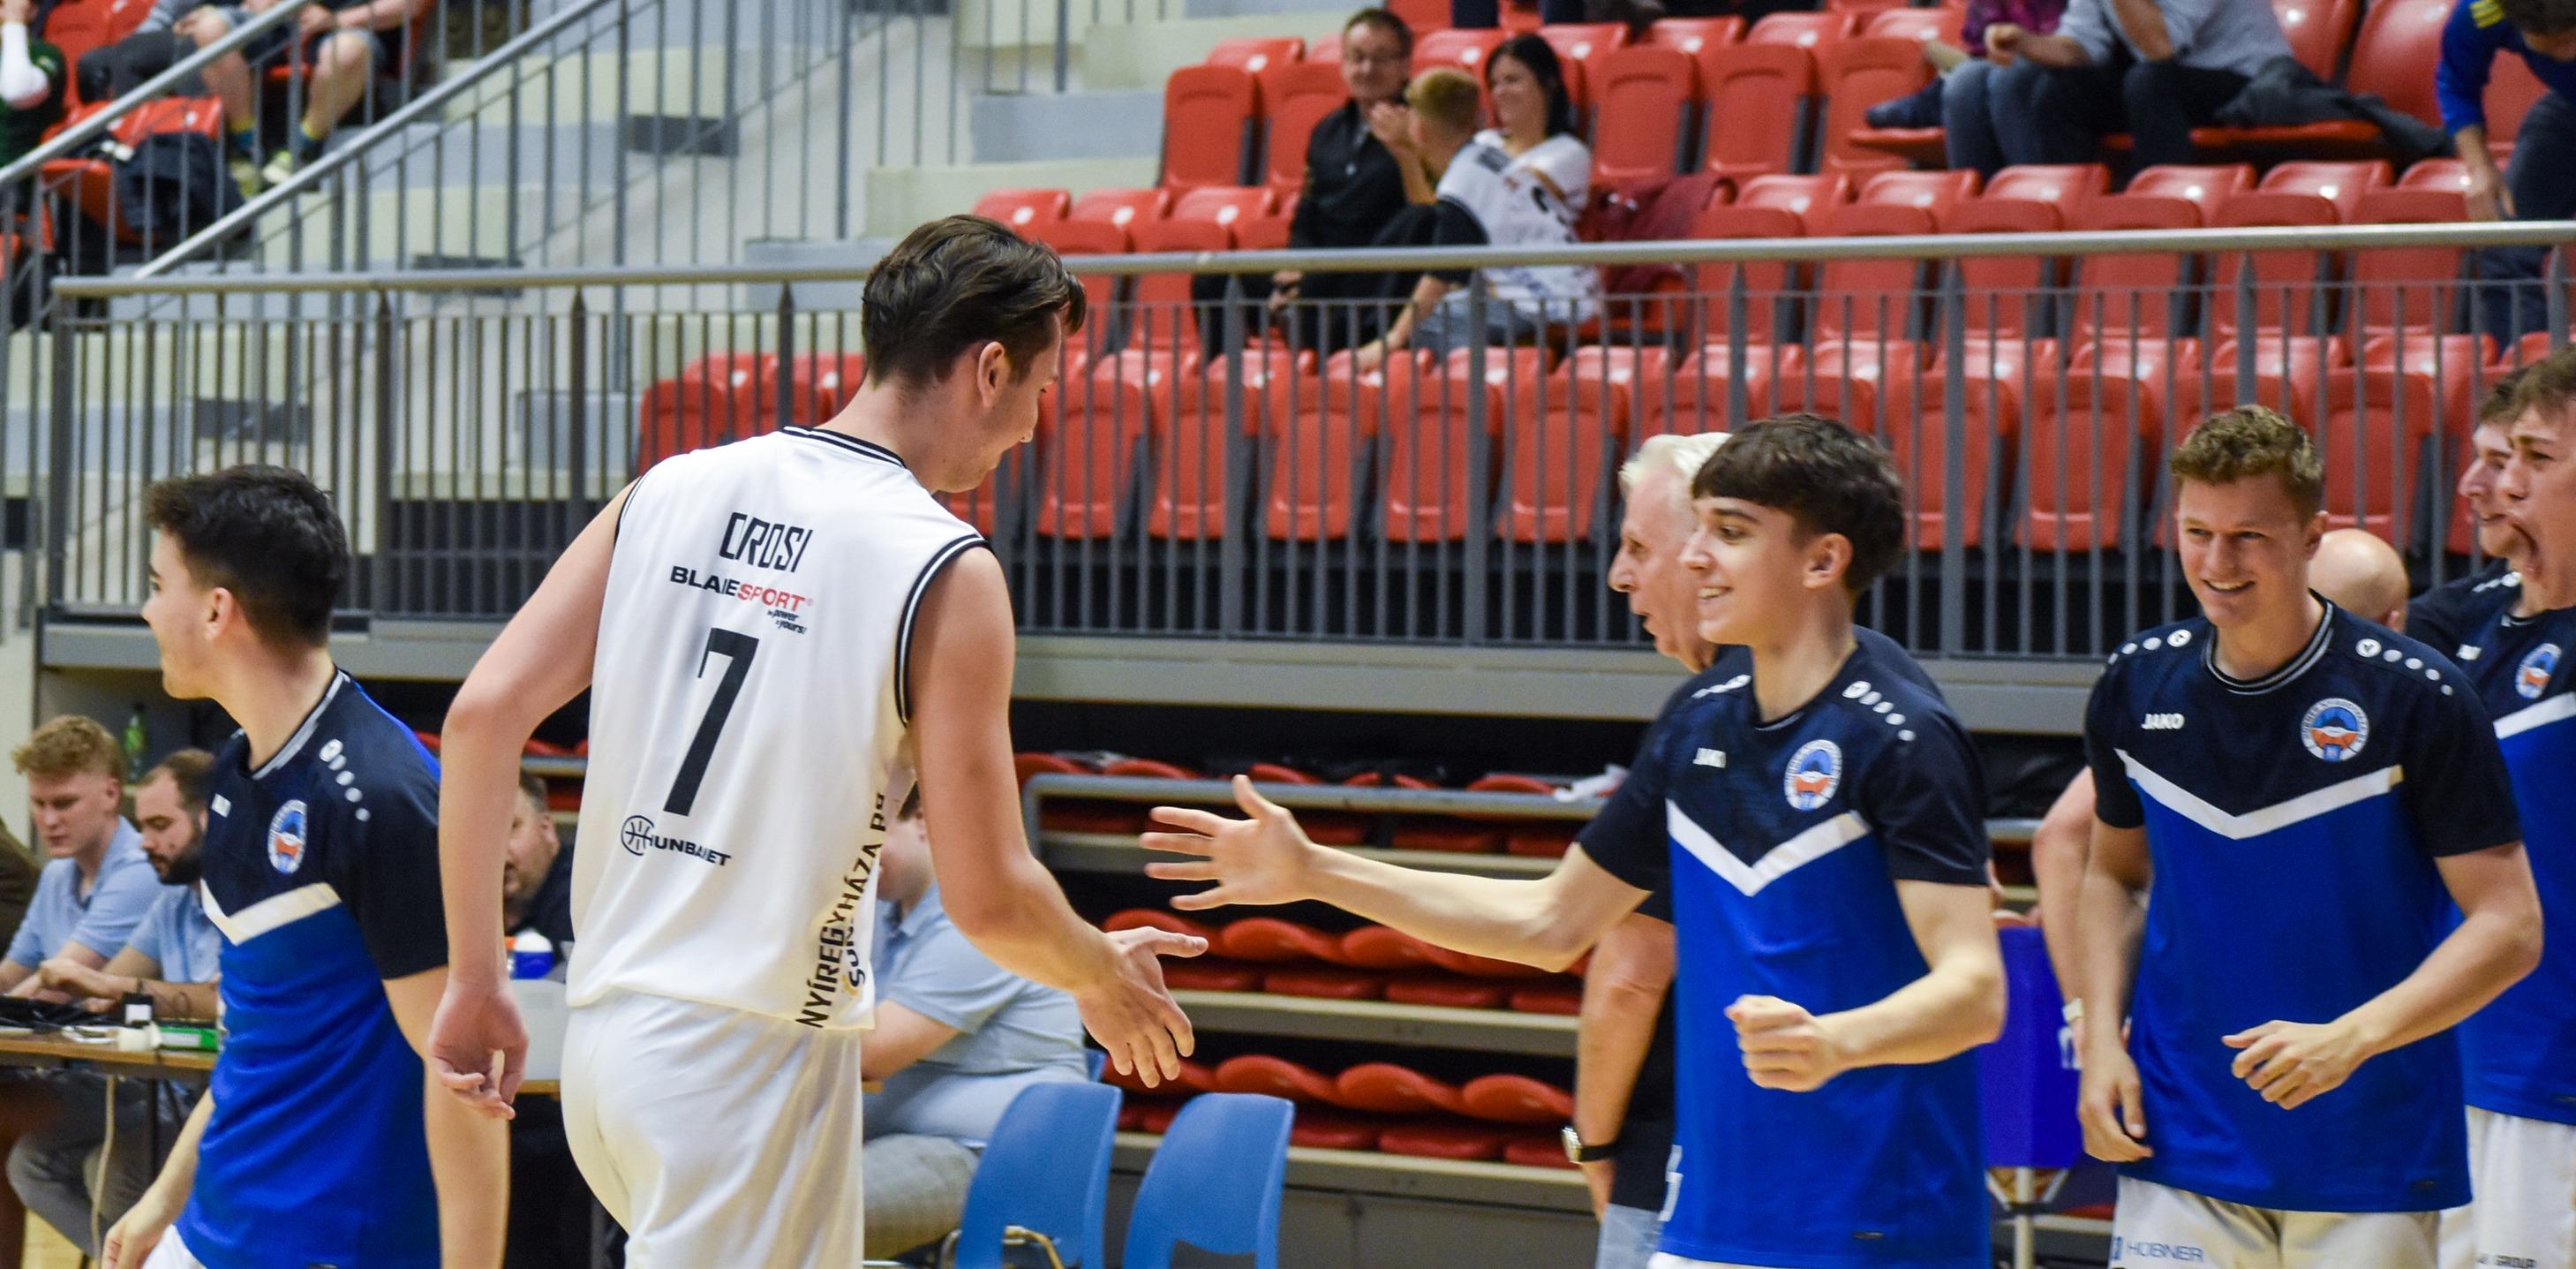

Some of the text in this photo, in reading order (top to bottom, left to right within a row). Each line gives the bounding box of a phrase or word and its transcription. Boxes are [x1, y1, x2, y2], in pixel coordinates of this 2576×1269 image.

[663, 627, 759, 816] 7
[2141, 713, 2185, 729] JAKO
[795, 842, 884, 1029] NYÍREGYHÁZA
